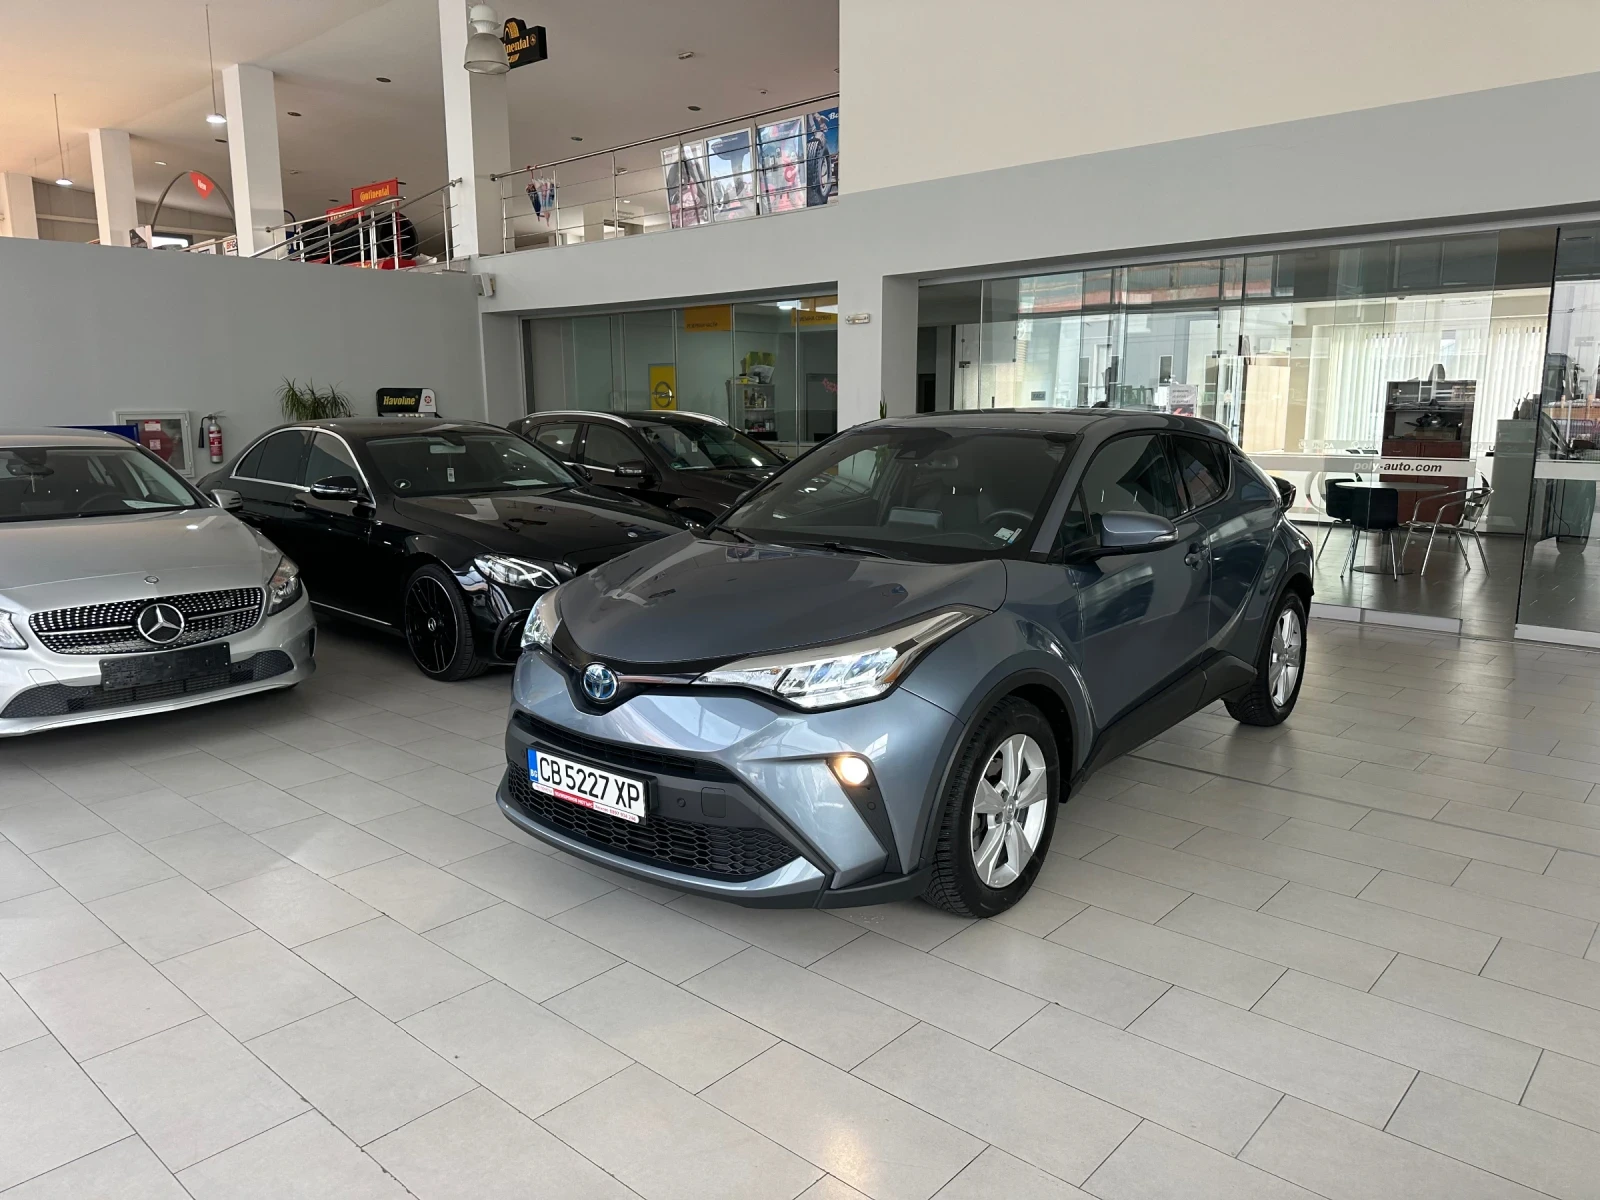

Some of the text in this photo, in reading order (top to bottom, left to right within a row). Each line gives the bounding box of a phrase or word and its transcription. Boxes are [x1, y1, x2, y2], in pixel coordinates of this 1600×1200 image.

[360, 185, 389, 202] Continental
[383, 396, 416, 405] Havoline
[1353, 461, 1442, 473] poly-auto.com
[530, 769, 538, 777] BG
[540, 757, 640, 809] CB 5227 XP
